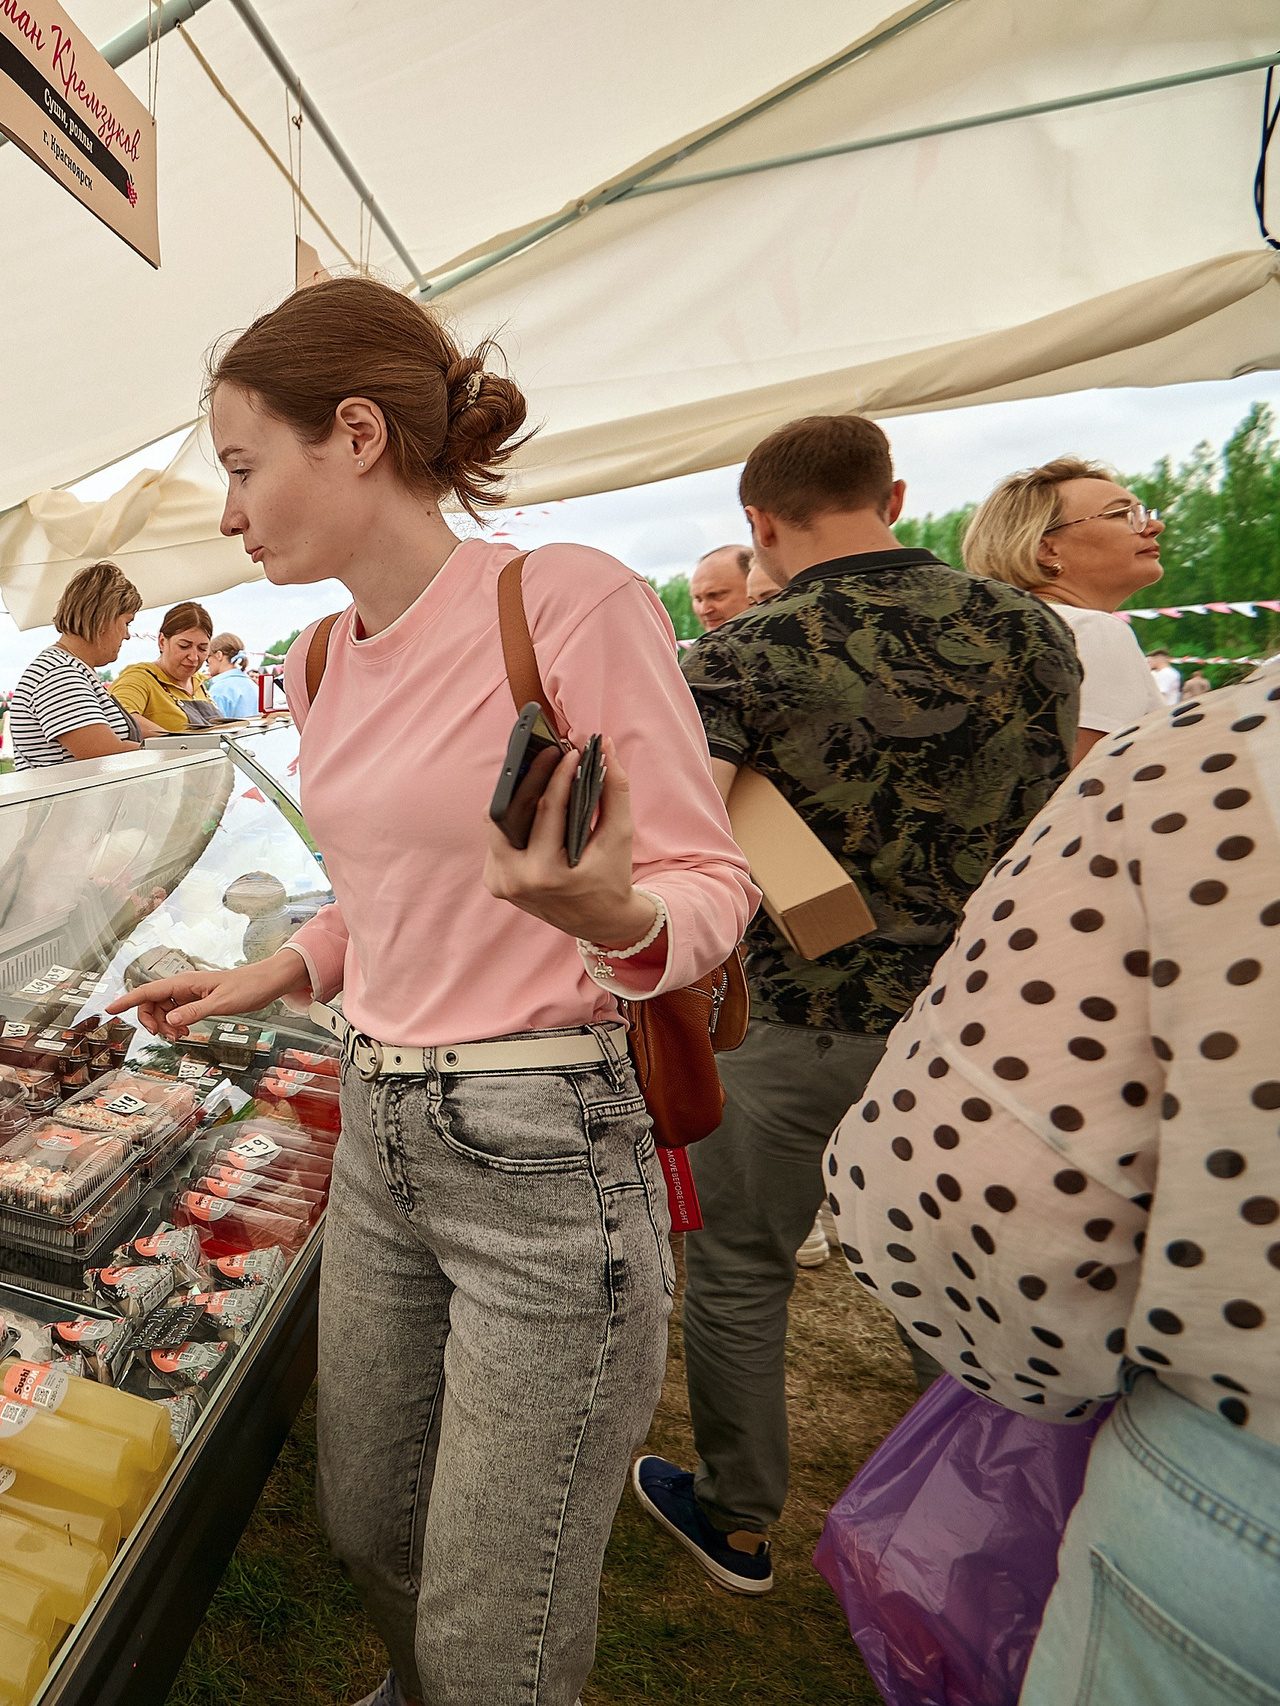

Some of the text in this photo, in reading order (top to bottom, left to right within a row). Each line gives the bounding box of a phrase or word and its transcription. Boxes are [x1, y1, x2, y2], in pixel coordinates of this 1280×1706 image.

[44, 88, 95, 154] Суши, роллы
[42, 130, 93, 191] г. Красноярск
[238, 1139, 270, 1154] 79
[666, 1149, 690, 1225] MOVE BEFORE FLIGHT
[13, 1368, 31, 1395] Sushi
[21, 1369, 40, 1400] ROOM
